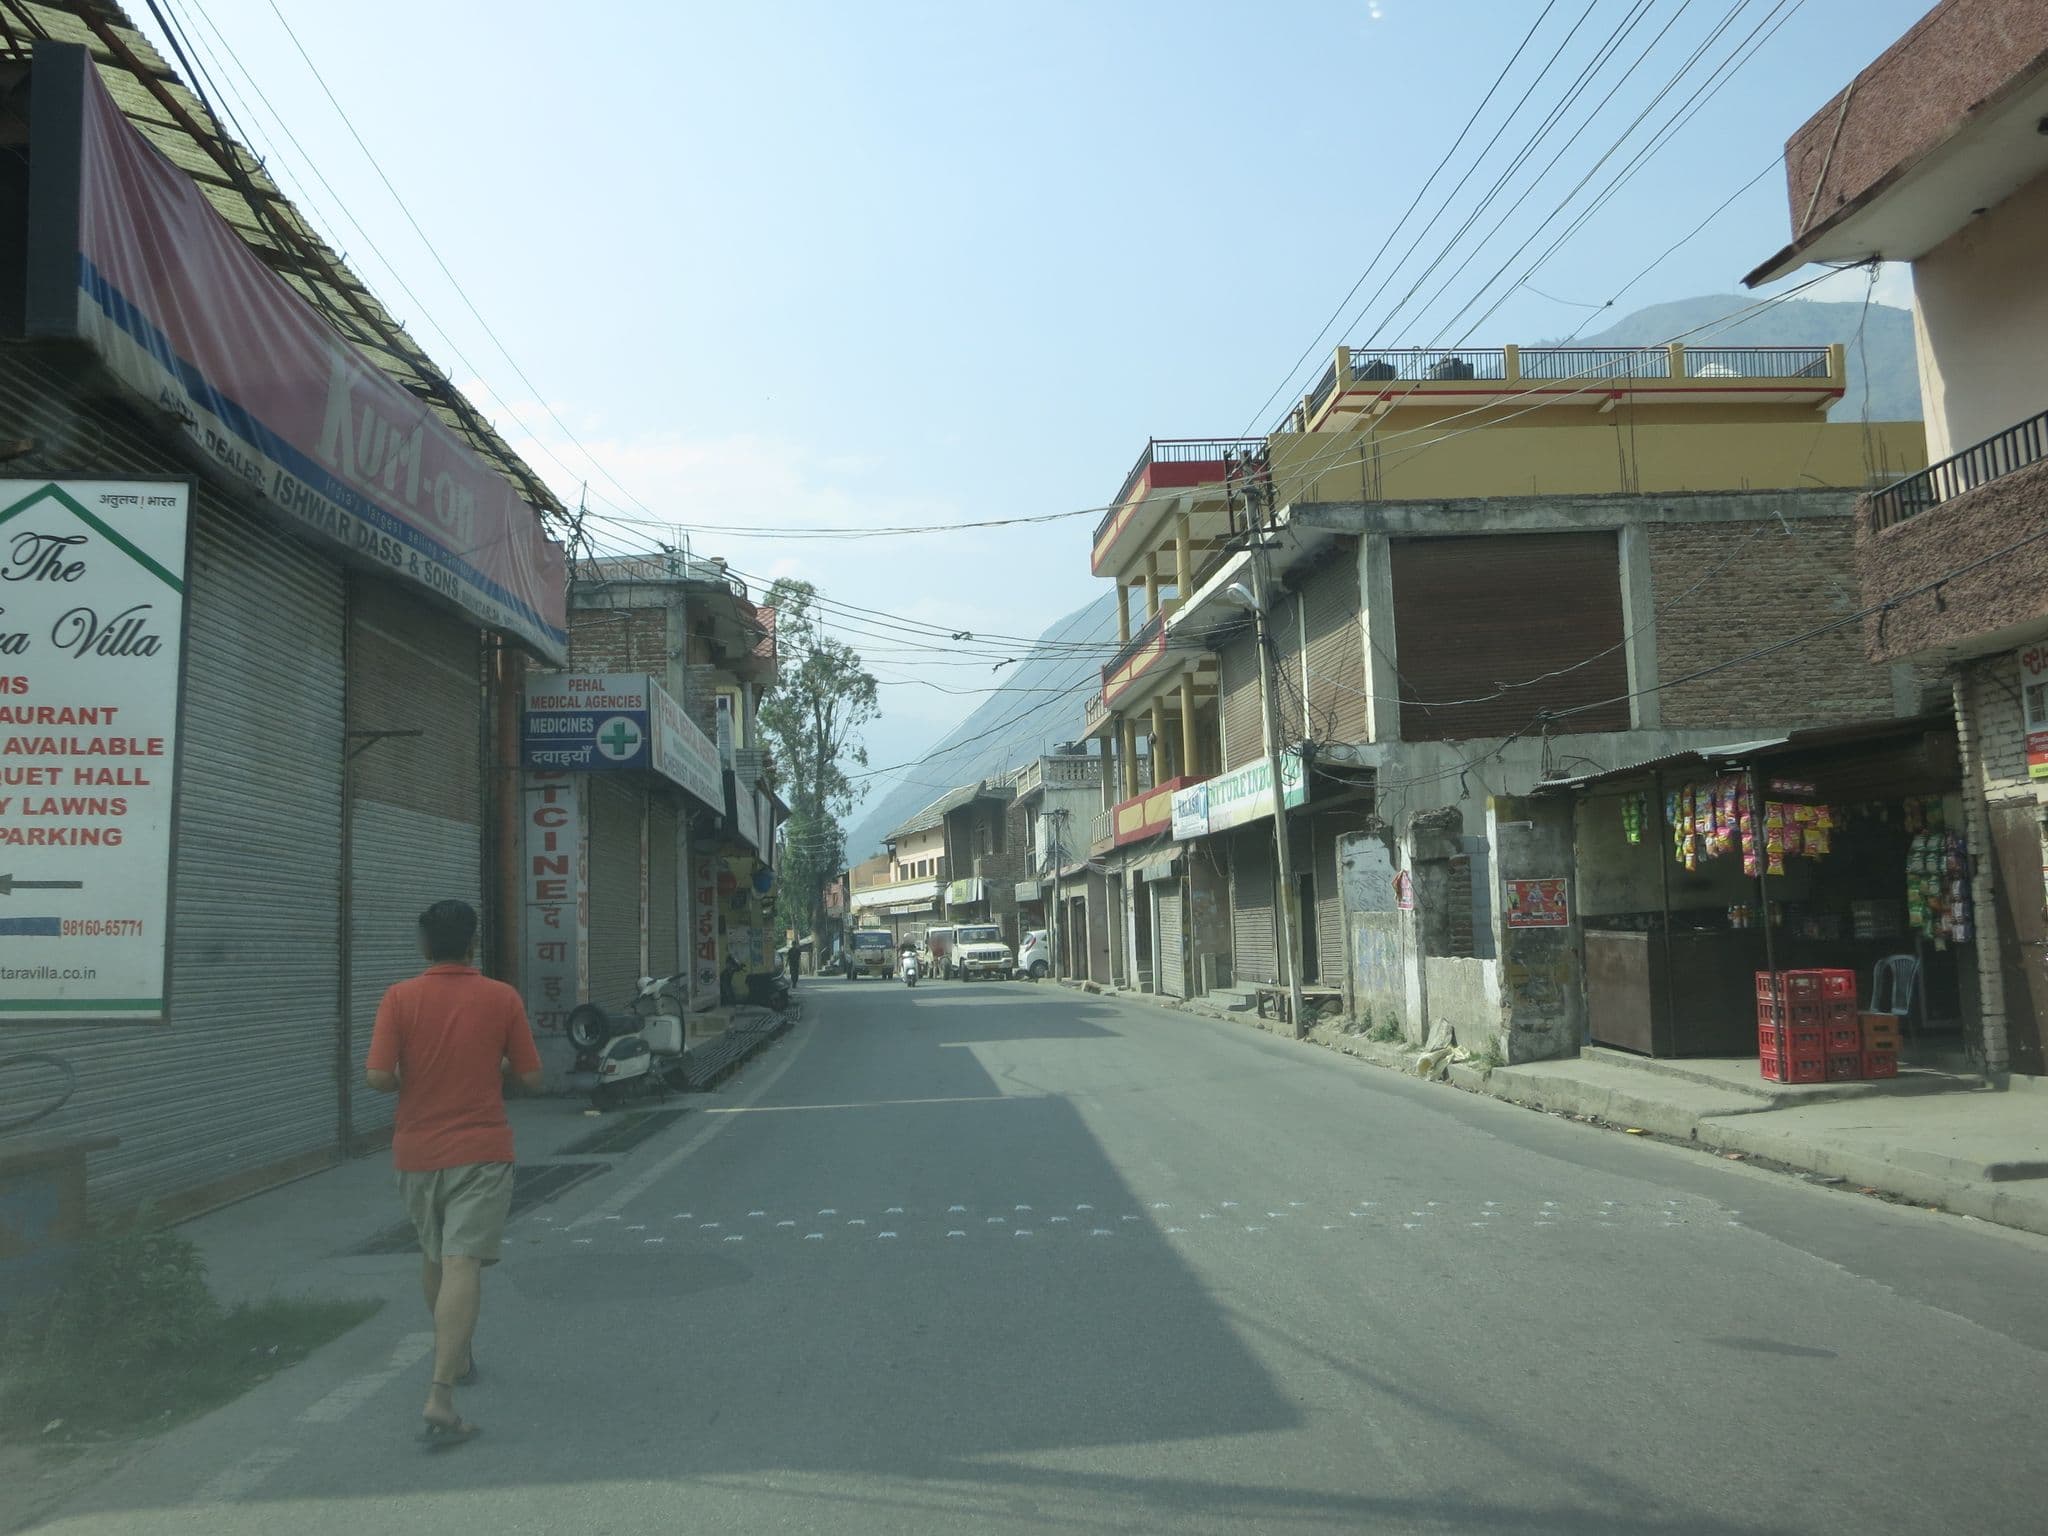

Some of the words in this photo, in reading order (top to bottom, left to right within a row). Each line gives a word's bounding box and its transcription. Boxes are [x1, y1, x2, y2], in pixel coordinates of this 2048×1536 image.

[147, 496, 177, 507] भारत
[366, 503, 403, 539] largest
[272, 469, 351, 540] ISHWAR
[358, 522, 403, 568] DASS
[409, 551, 420, 576] &
[424, 559, 460, 600] SONS
[1, 531, 88, 582] The
[52, 604, 162, 660] Villa
[568, 679, 605, 692] PEHAL
[530, 695, 581, 709] MEDICAL
[585, 695, 642, 708] AGENCIES
[0, 706, 118, 725] AURANT
[530, 717, 594, 733] MEDICINES
[3, 737, 164, 756] AVAILABLE
[0, 767, 63, 786] UET
[74, 767, 150, 785] HALL
[23, 797, 127, 815] LAWNS
[0, 827, 123, 846] PARKING
[62, 920, 143, 936] 98160-65771
